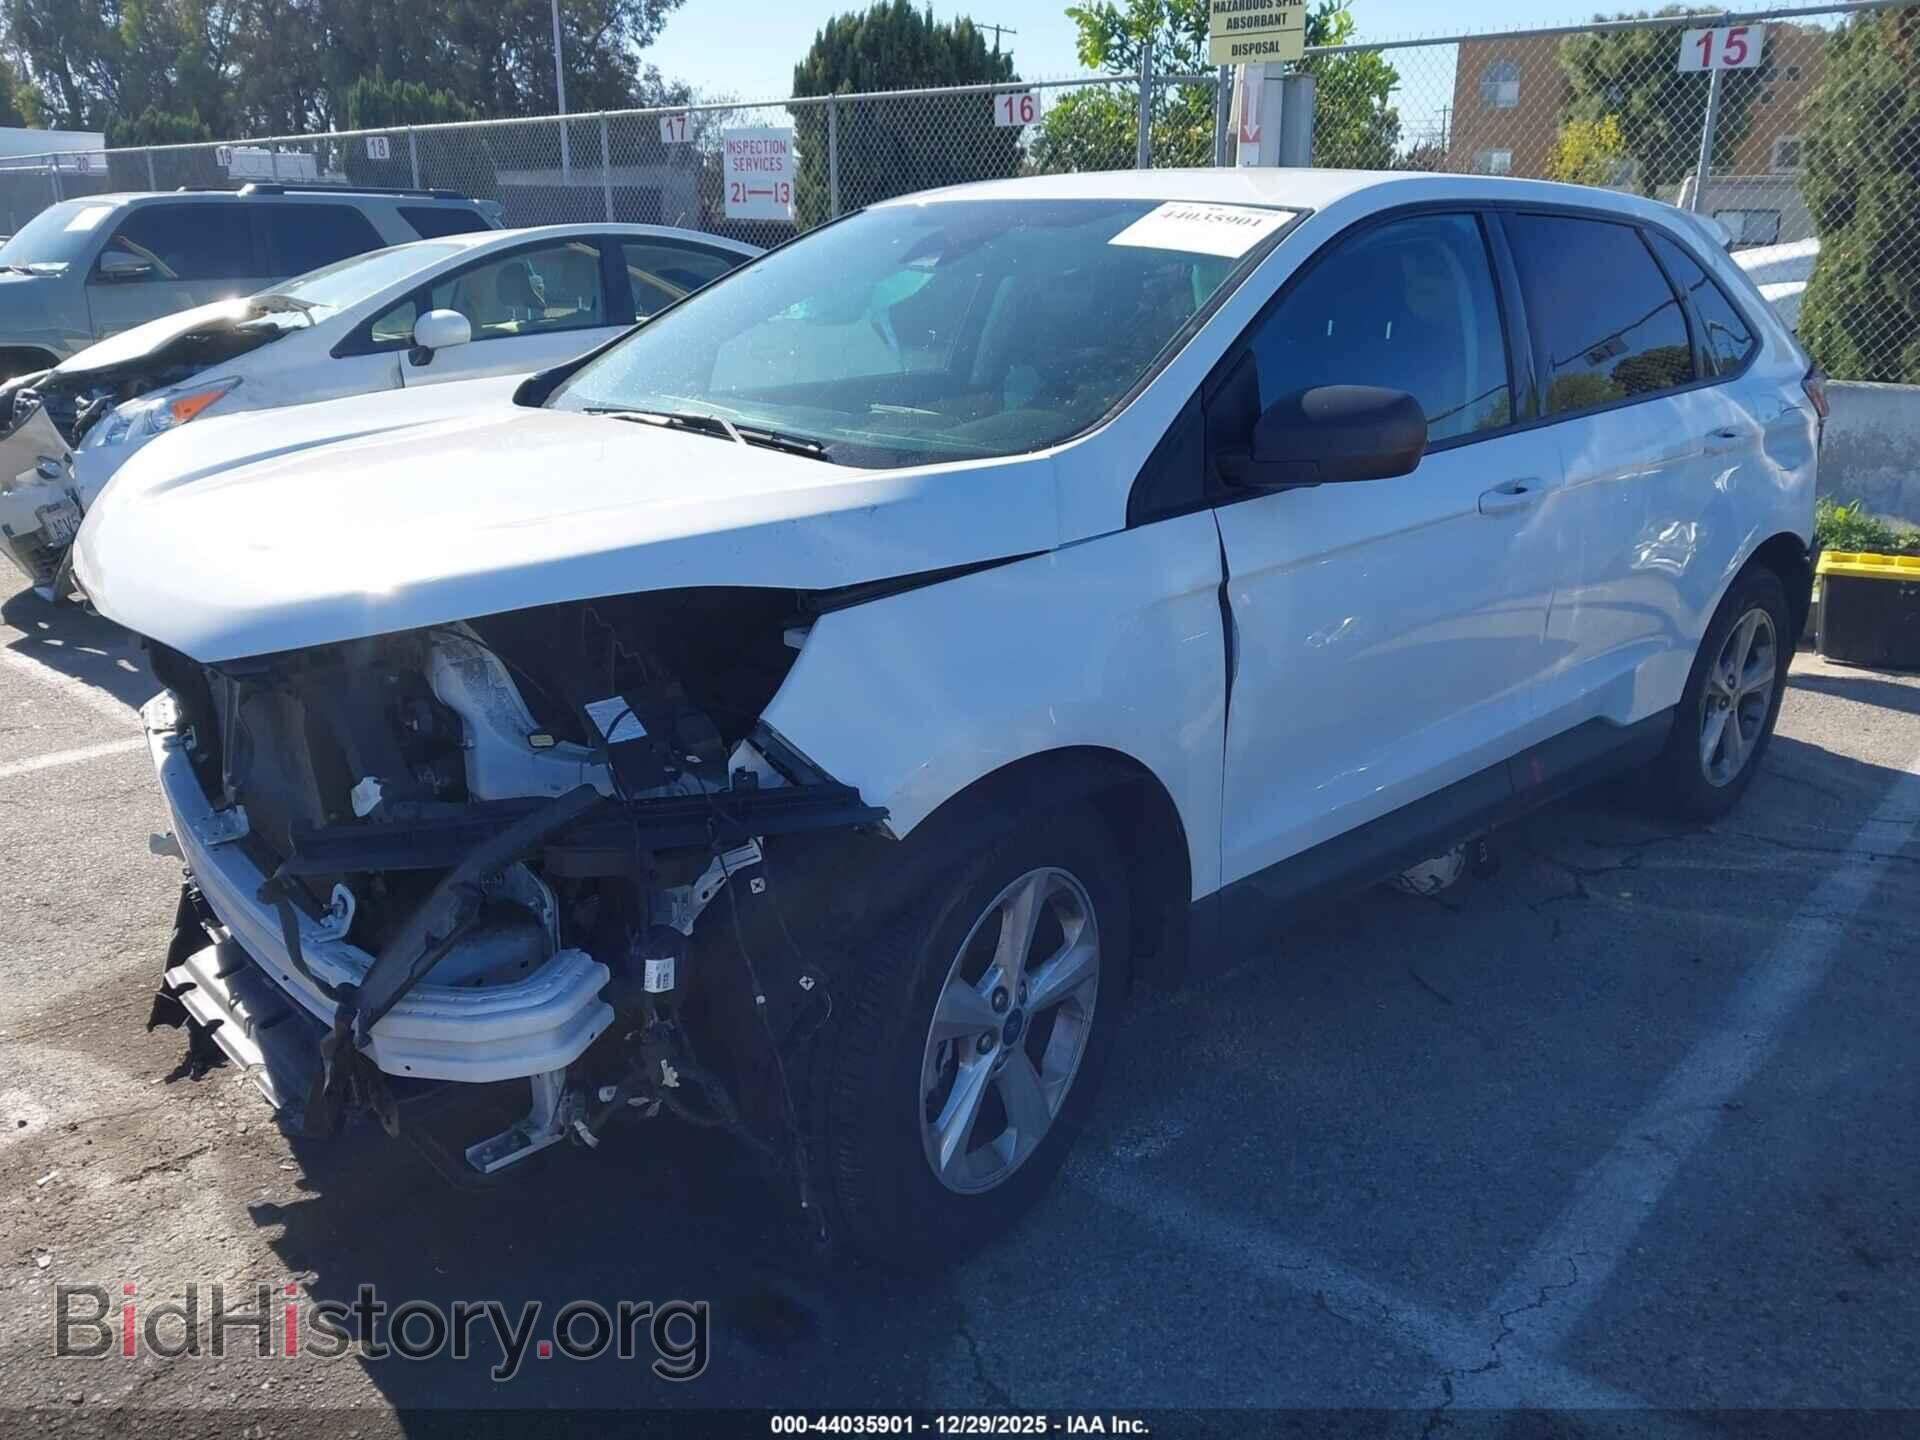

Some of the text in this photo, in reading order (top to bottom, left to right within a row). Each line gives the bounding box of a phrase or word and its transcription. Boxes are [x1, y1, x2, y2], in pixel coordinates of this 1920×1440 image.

[1213, 0, 1273, 14] HAZARDOUS
[1226, 12, 1287, 30] ABSORBANT
[1231, 40, 1280, 56] DISPOSAL
[1696, 26, 1749, 67] 15
[1004, 95, 1034, 124] 16
[666, 117, 686, 141] 17
[370, 138, 385, 156] 18
[726, 139, 787, 154] INSPECTION
[733, 156, 784, 172] SERVICES
